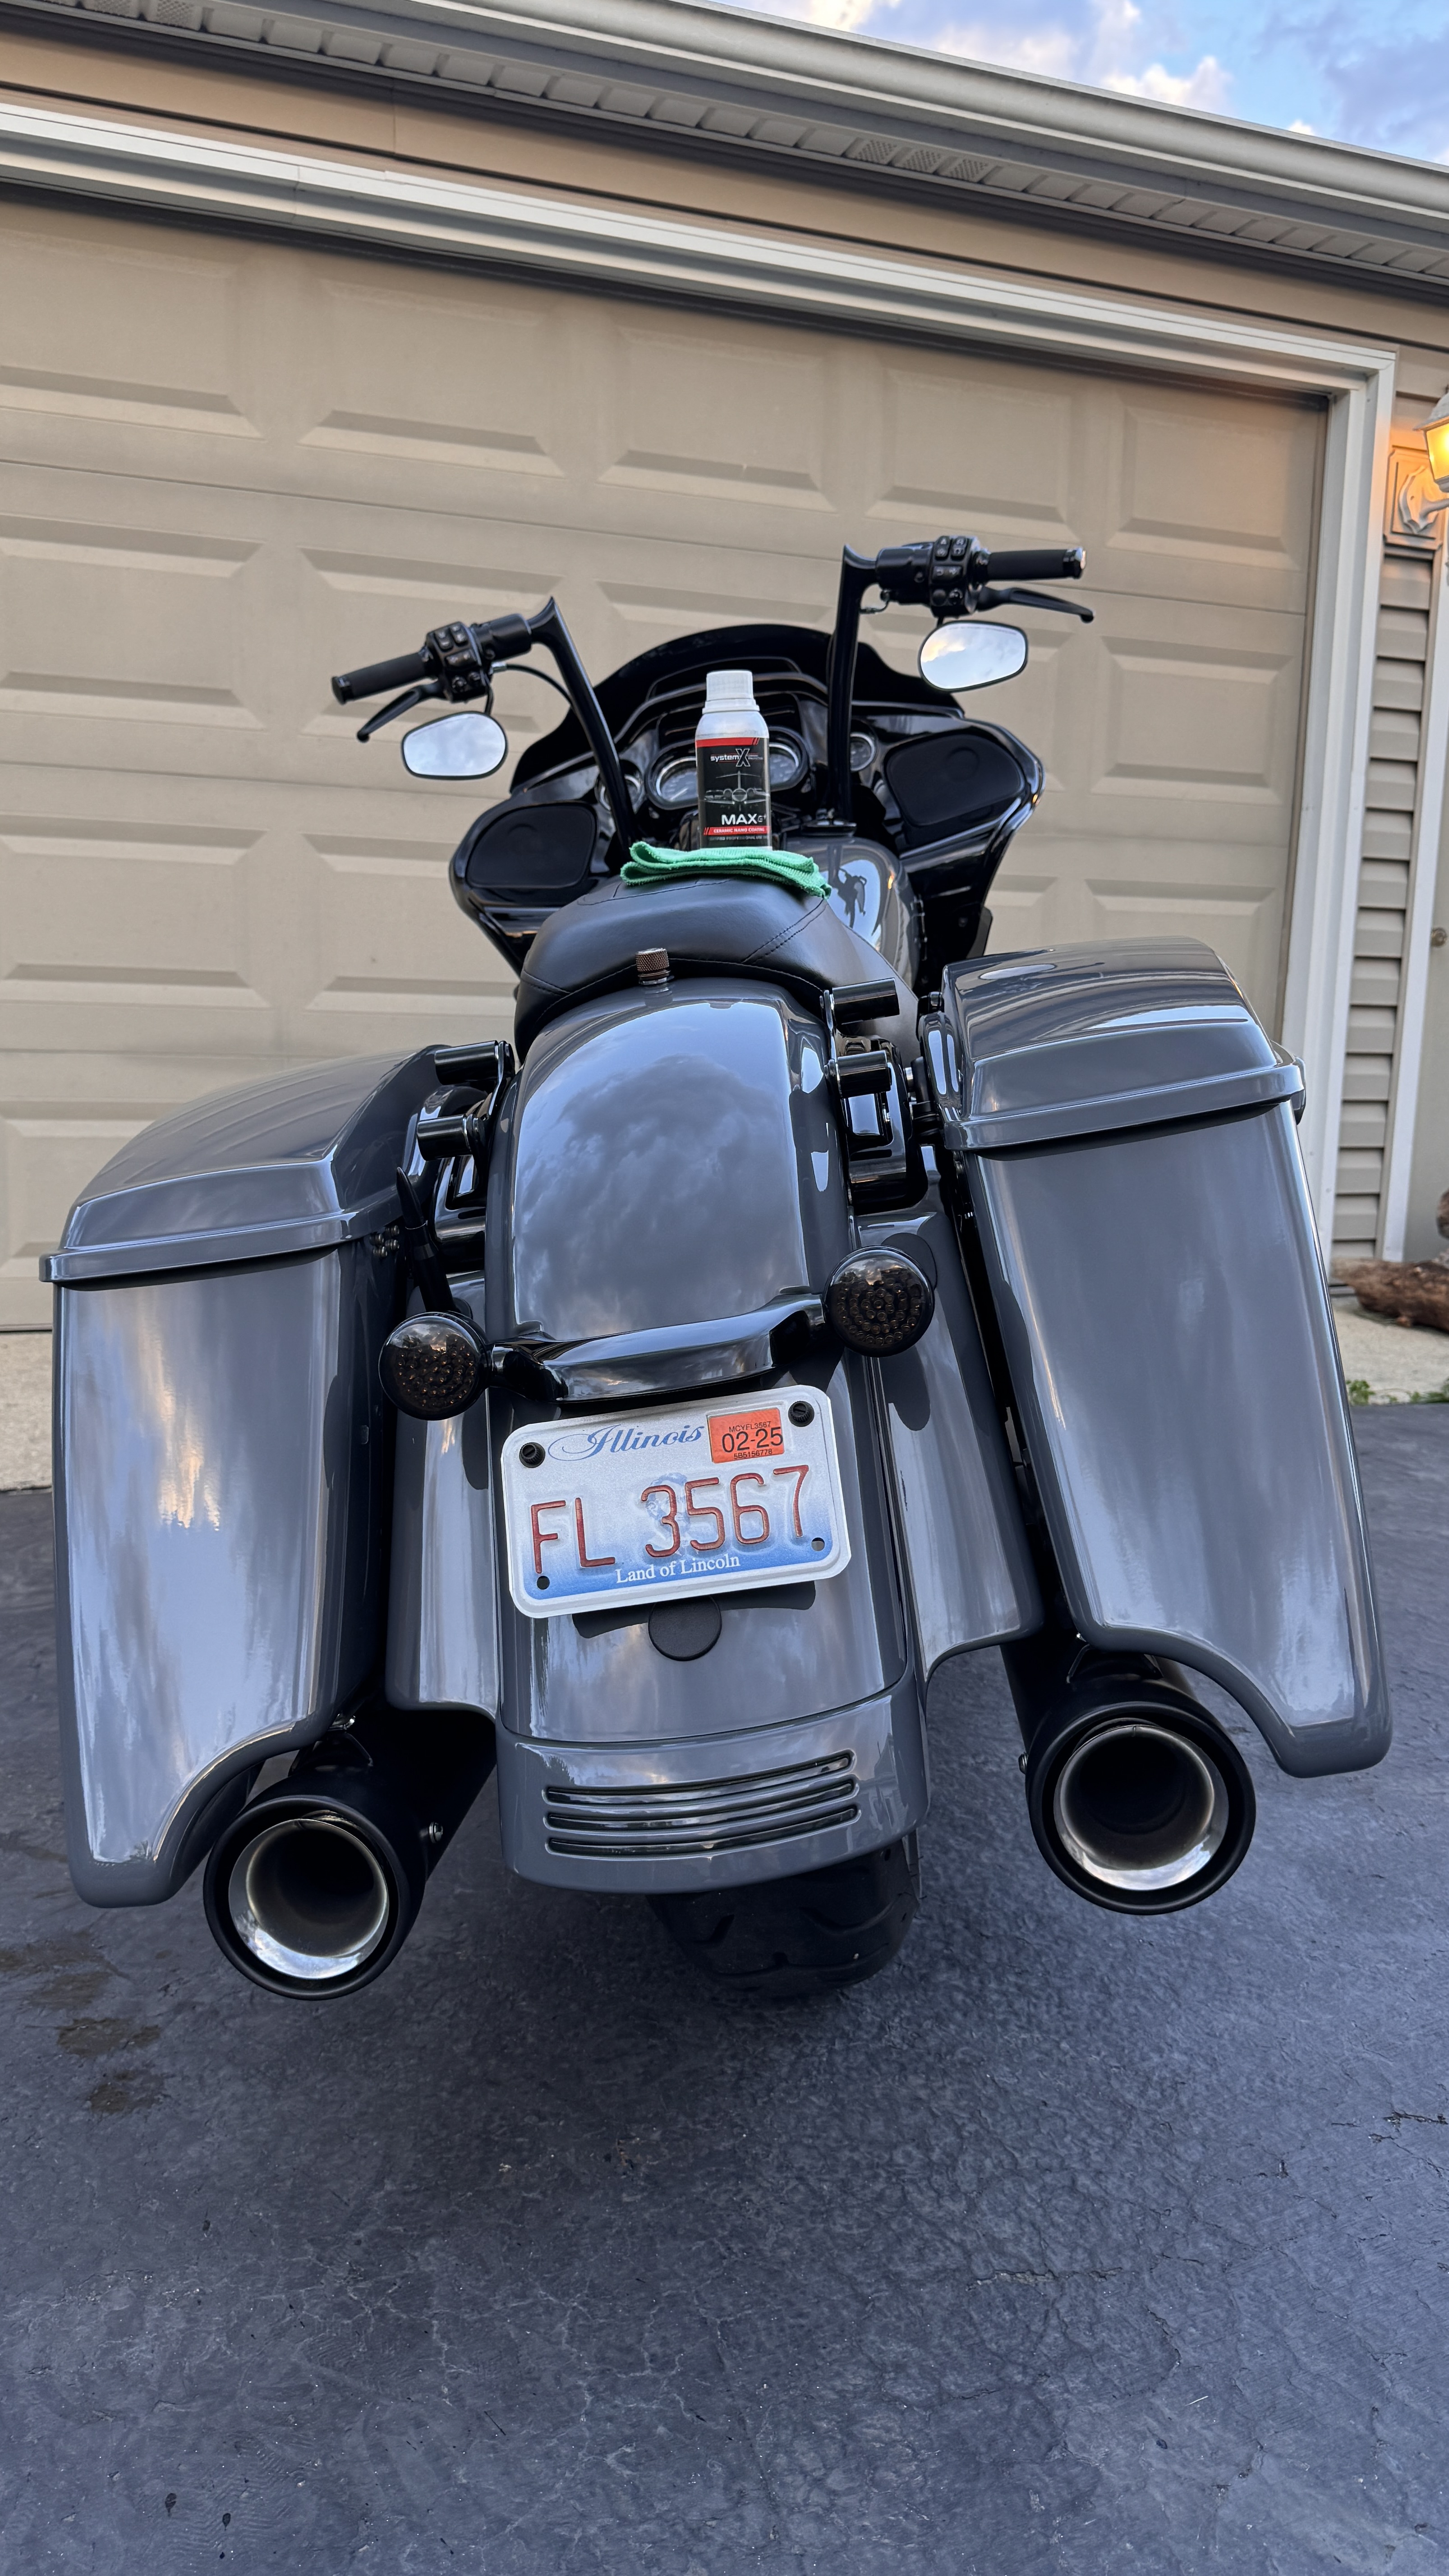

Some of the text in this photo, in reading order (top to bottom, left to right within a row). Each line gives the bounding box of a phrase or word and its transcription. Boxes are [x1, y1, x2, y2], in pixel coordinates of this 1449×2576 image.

[722, 814, 758, 825] MAX
[722, 1426, 783, 1453] 02-25
[729, 1421, 771, 1433] MCYFL3567
[548, 1424, 704, 1461] Illinois
[734, 1449, 773, 1459] 5B5156778
[531, 1464, 809, 1574] FL 3567
[615, 1553, 741, 1583] Land of Lincoln
